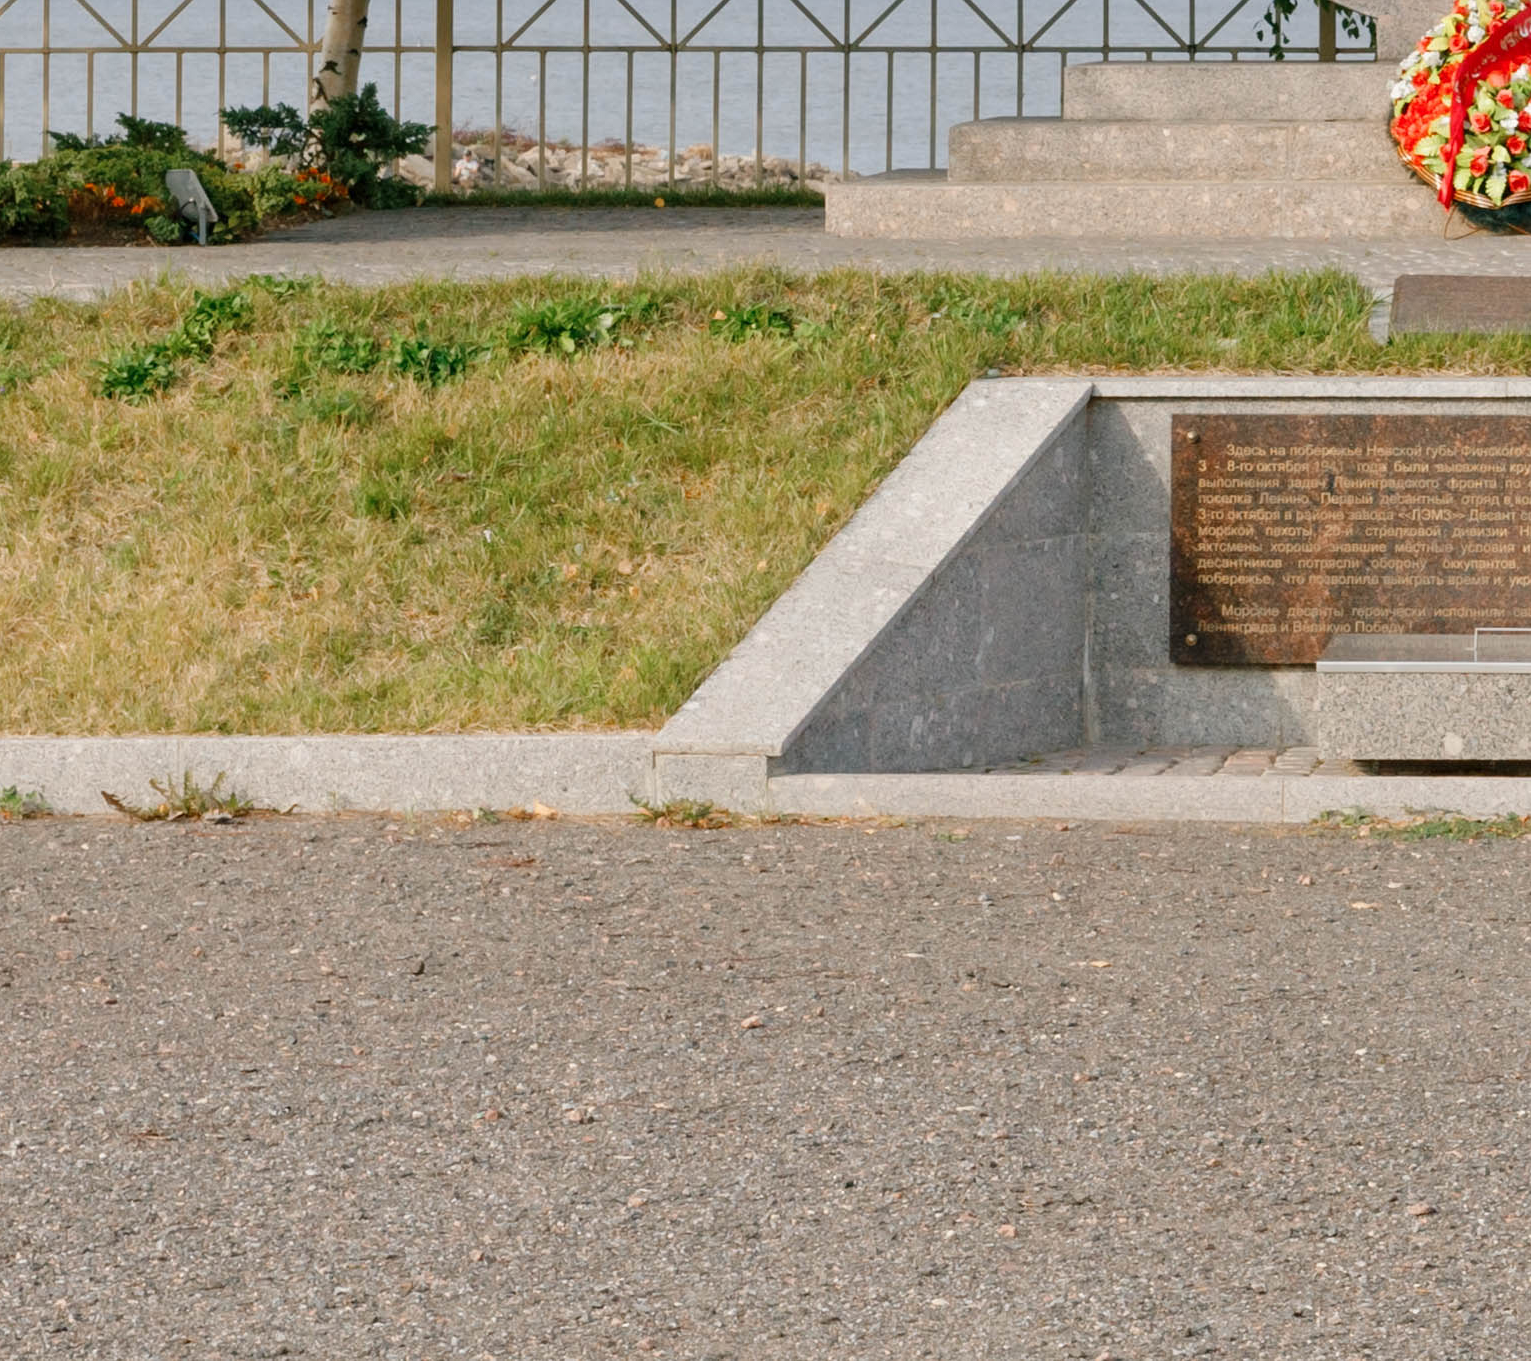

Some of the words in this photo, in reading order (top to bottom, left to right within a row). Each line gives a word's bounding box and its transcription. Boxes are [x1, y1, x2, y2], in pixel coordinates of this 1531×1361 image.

[1226, 444, 1266, 459] Здесь
[1290, 444, 1362, 459] побережье
[1366, 444, 1422, 456] Невской
[1426, 445, 1456, 460] губы
[1461, 445, 1522, 457] Финского
[1227, 460, 1253, 472] 8-го
[1256, 460, 1309, 475] октября
[1314, 460, 1345, 472] 1941
[1357, 463, 1387, 475] года
[1394, 461, 1429, 473] были
[1436, 464, 1506, 473] высажены
[1198, 479, 1279, 488] выполнения
[1287, 479, 1326, 491] задач
[1334, 476, 1439, 491] Ленинградского
[1447, 477, 1497, 492] фронта
[1198, 495, 1252, 504] поселка
[1320, 492, 1373, 507] Первый
[1380, 493, 1453, 508] десантный
[1461, 496, 1500, 508] отряд
[1198, 508, 1224, 520] 3-го
[1228, 508, 1280, 523] октября
[1296, 508, 1344, 523] районе
[1348, 511, 1394, 523] завода
[1469, 509, 1516, 524] Десант
[1198, 524, 1254, 539] морской
[1365, 524, 1441, 539] стрелковой
[1452, 528, 1507, 540] дивизии
[1329, 543, 1386, 553] знавшие
[1395, 544, 1453, 554] местные
[1461, 544, 1514, 557] условия
[1197, 559, 1282, 572] десантников
[1297, 559, 1359, 572] потрясли
[1371, 557, 1427, 572] оборону
[1309, 575, 1379, 585] позволило
[1383, 576, 1445, 589] выиграть
[1448, 576, 1489, 589] время
[1221, 604, 1280, 620] Морские
[1287, 607, 1344, 620] десанты
[1352, 607, 1426, 620] героически
[1434, 608, 1505, 618] исполнили
[1198, 620, 1276, 635] Ленинграда
[1293, 620, 1350, 635] Великую
[1355, 620, 1404, 635] Победу
